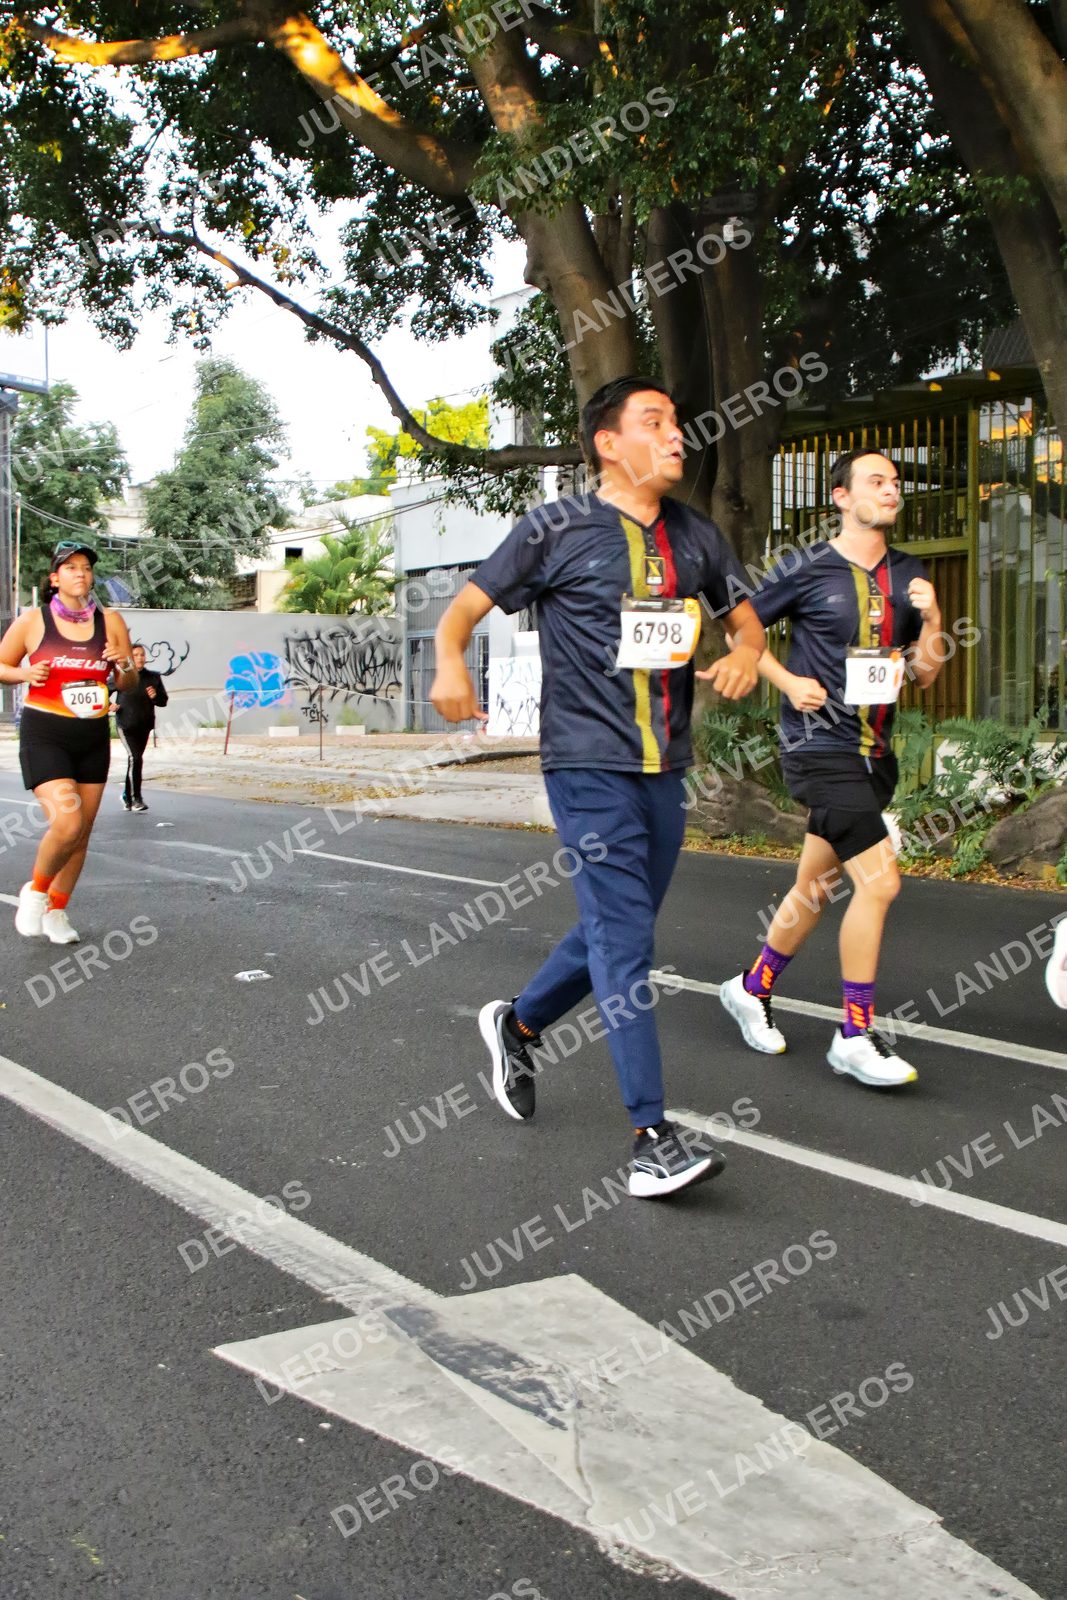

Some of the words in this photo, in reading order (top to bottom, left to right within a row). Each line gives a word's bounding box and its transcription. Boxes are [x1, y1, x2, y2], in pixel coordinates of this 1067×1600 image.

[633, 622, 683, 645] 6798
[868, 666, 886, 683] 80
[70, 692, 98, 705] 2061
